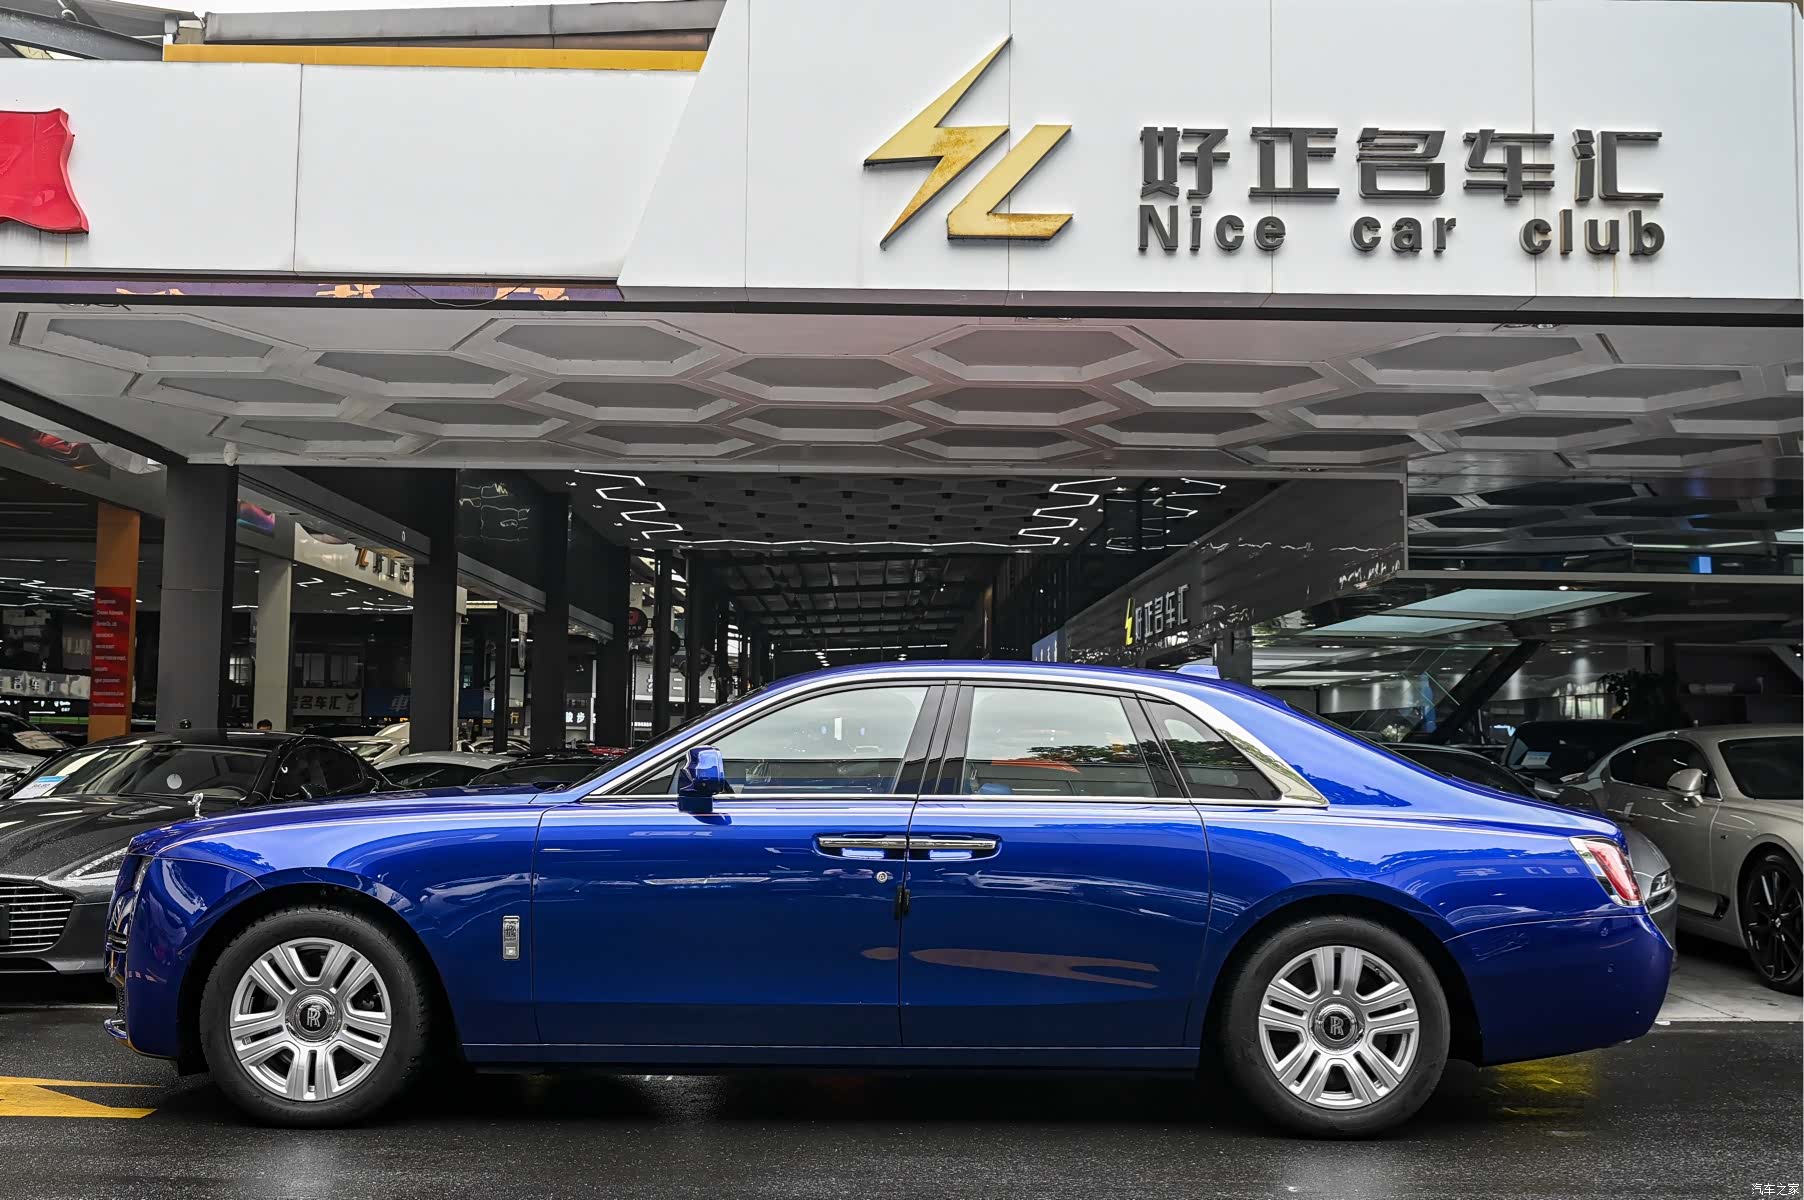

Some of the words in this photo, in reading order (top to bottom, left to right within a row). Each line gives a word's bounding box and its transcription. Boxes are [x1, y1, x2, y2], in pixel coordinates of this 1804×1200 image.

[1139, 126, 1665, 202] 好正名车汇
[1138, 204, 1286, 252] Nice
[1352, 215, 1457, 253] car
[1519, 209, 1666, 256] club
